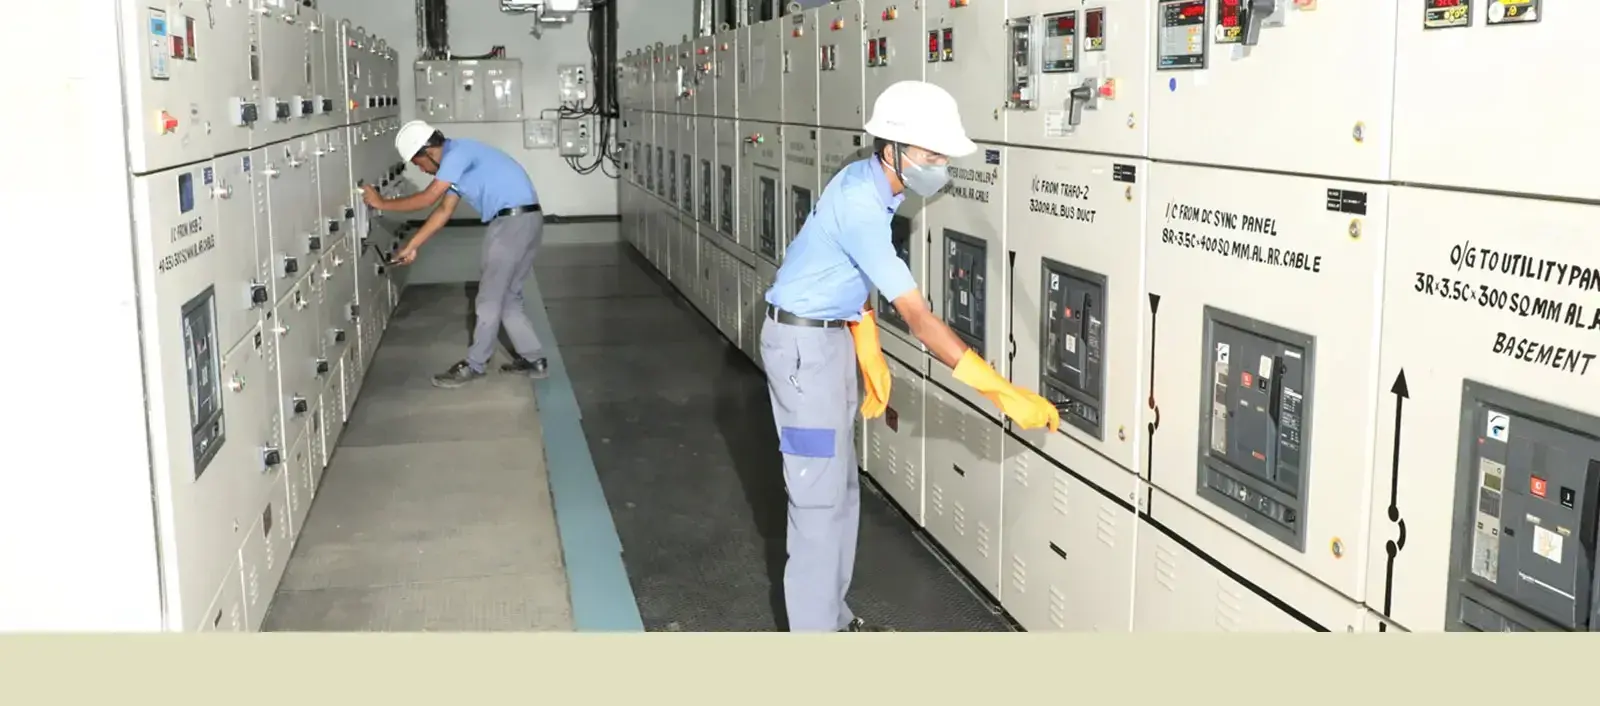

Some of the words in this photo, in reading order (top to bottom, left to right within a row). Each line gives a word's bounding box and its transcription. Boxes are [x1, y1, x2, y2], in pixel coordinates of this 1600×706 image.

[1041, 180, 1059, 195] FROM
[1061, 183, 1090, 200] TRAFO-2
[1076, 207, 1097, 223] DUCT
[1165, 196, 1178, 223] I/C
[1179, 203, 1200, 222] FROM
[1201, 208, 1213, 224] DC
[1214, 210, 1238, 230] SYNC
[1241, 215, 1278, 236] PANEL
[1450, 240, 1476, 271] O/G
[1480, 248, 1499, 271] TO
[1501, 252, 1568, 285] UTILITY
[1492, 331, 1597, 376] BASEMENT
